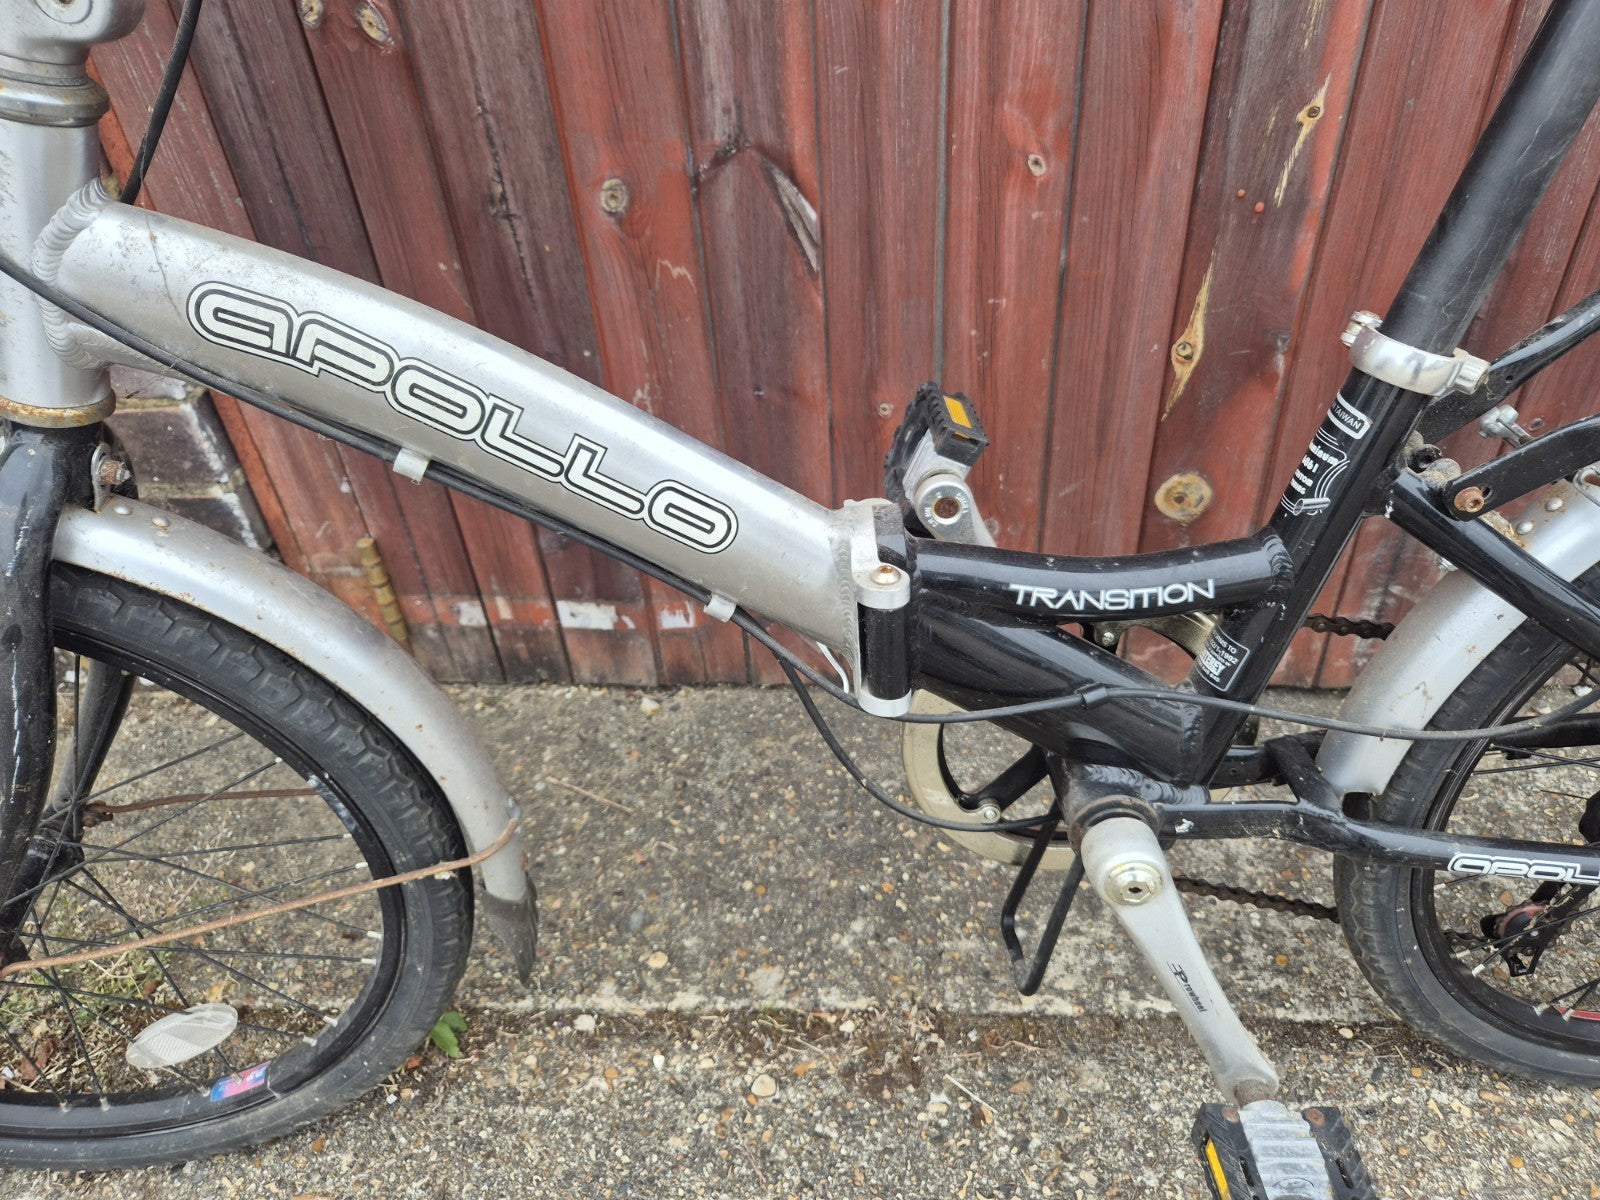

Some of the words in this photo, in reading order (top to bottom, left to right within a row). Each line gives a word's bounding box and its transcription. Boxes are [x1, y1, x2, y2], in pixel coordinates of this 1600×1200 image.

[186, 280, 739, 554] APOLLO
[1334, 405, 1362, 430] TAIWAN
[1009, 578, 1215, 611] TRANSITION
[1169, 963, 1208, 1013] Prowheel
